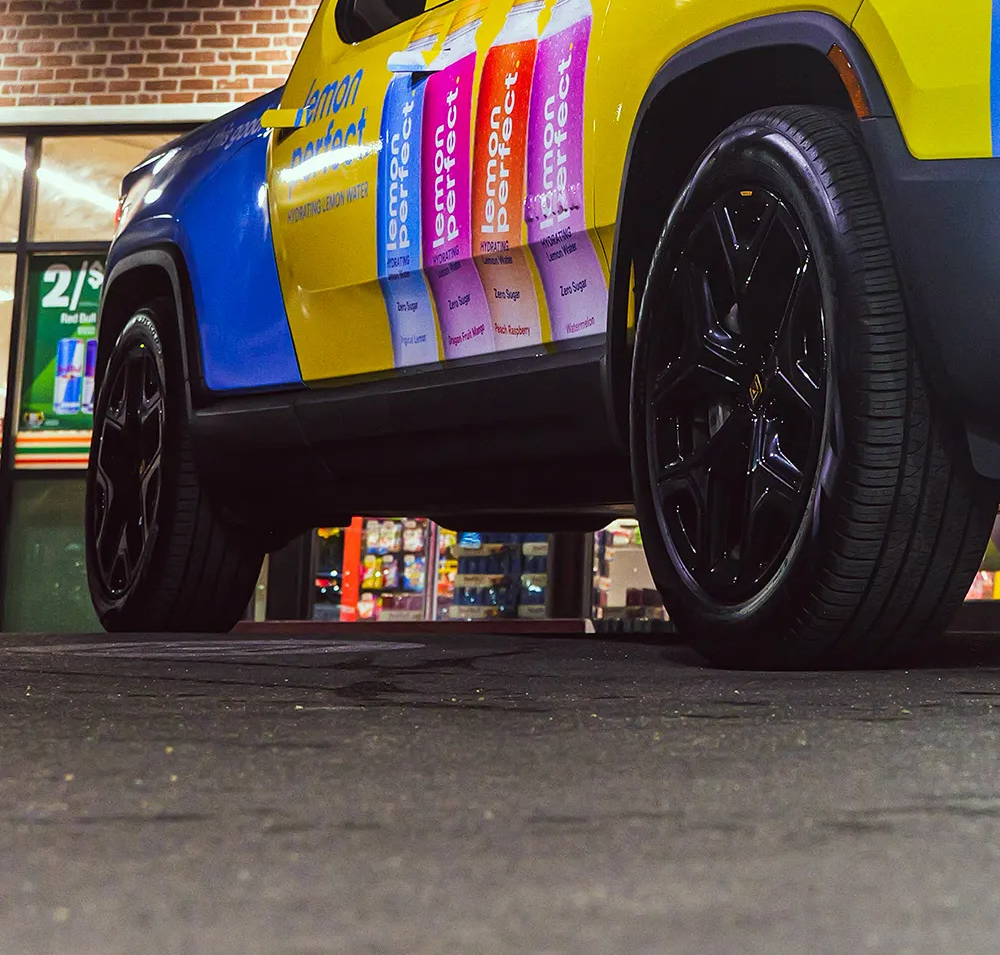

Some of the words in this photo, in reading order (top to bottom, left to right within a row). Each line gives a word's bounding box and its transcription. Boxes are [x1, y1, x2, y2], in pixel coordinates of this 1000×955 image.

[294, 68, 364, 127] lemon
[481, 106, 501, 233] lemon
[540, 95, 555, 231] lemon
[386, 132, 400, 251] lemon
[432, 124, 445, 248] lemon
[287, 198, 321, 223] HYDRATING
[322, 190, 345, 212] LEMON
[346, 181, 369, 203] WATER
[480, 240, 509, 252] HYDRATING
[540, 226, 573, 249] HYDRATING
[545, 249, 564, 262] Lemon
[560, 243, 577, 256] Water
[493, 288, 506, 299] Zero
[506, 288, 520, 301] Sugar
[560, 285, 573, 296] Zero
[571, 279, 588, 292] Sugar
[458, 293, 471, 306] Sugar
[508, 325, 531, 337] Raspberry
[566, 317, 596, 333] Watermelon
